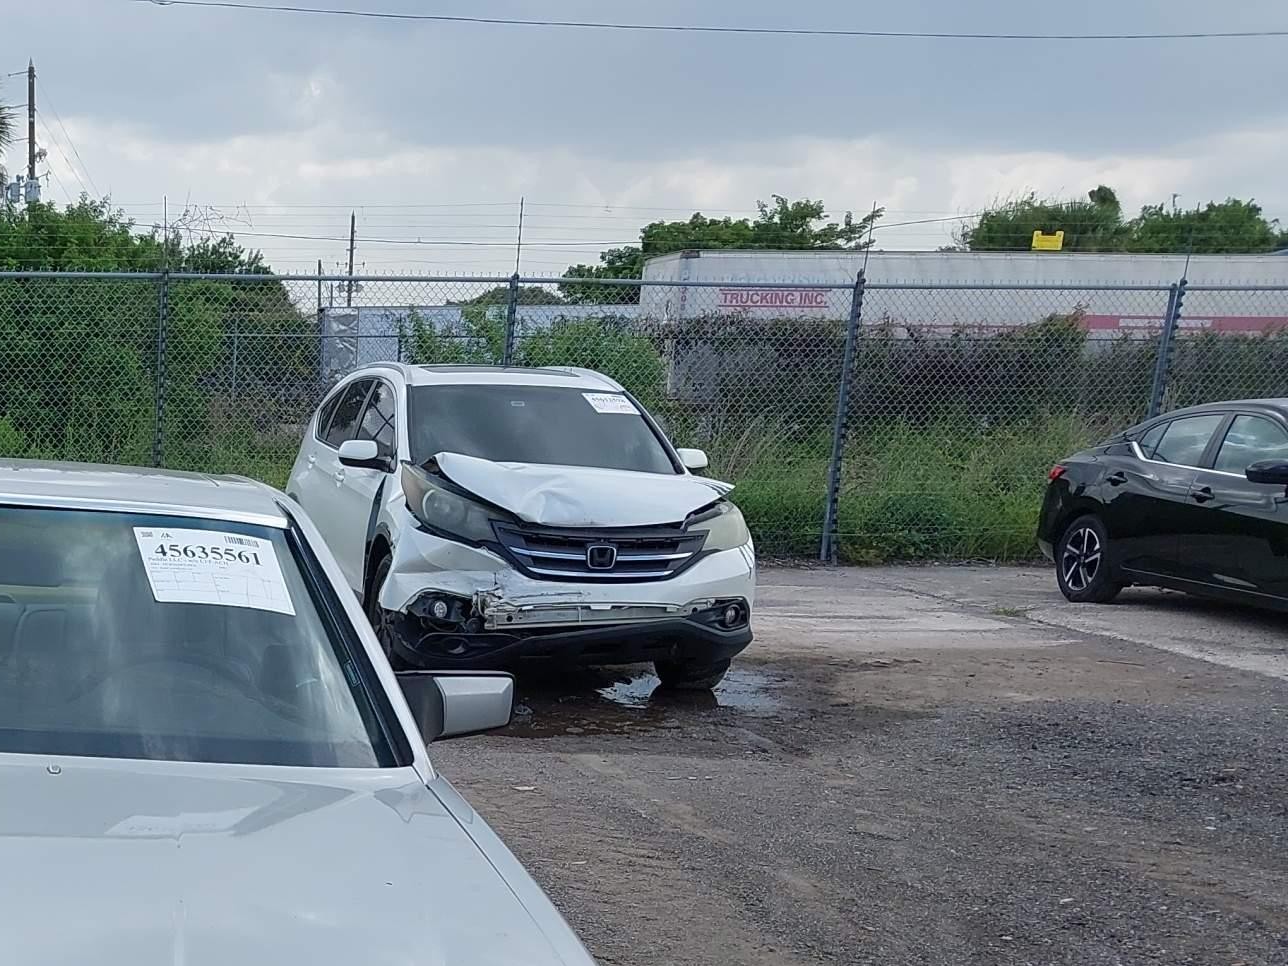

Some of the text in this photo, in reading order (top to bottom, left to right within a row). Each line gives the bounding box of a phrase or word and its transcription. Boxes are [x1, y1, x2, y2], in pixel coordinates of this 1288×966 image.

[721, 292, 827, 305] TRUCKING INC.
[154, 543, 263, 566] 45635561
